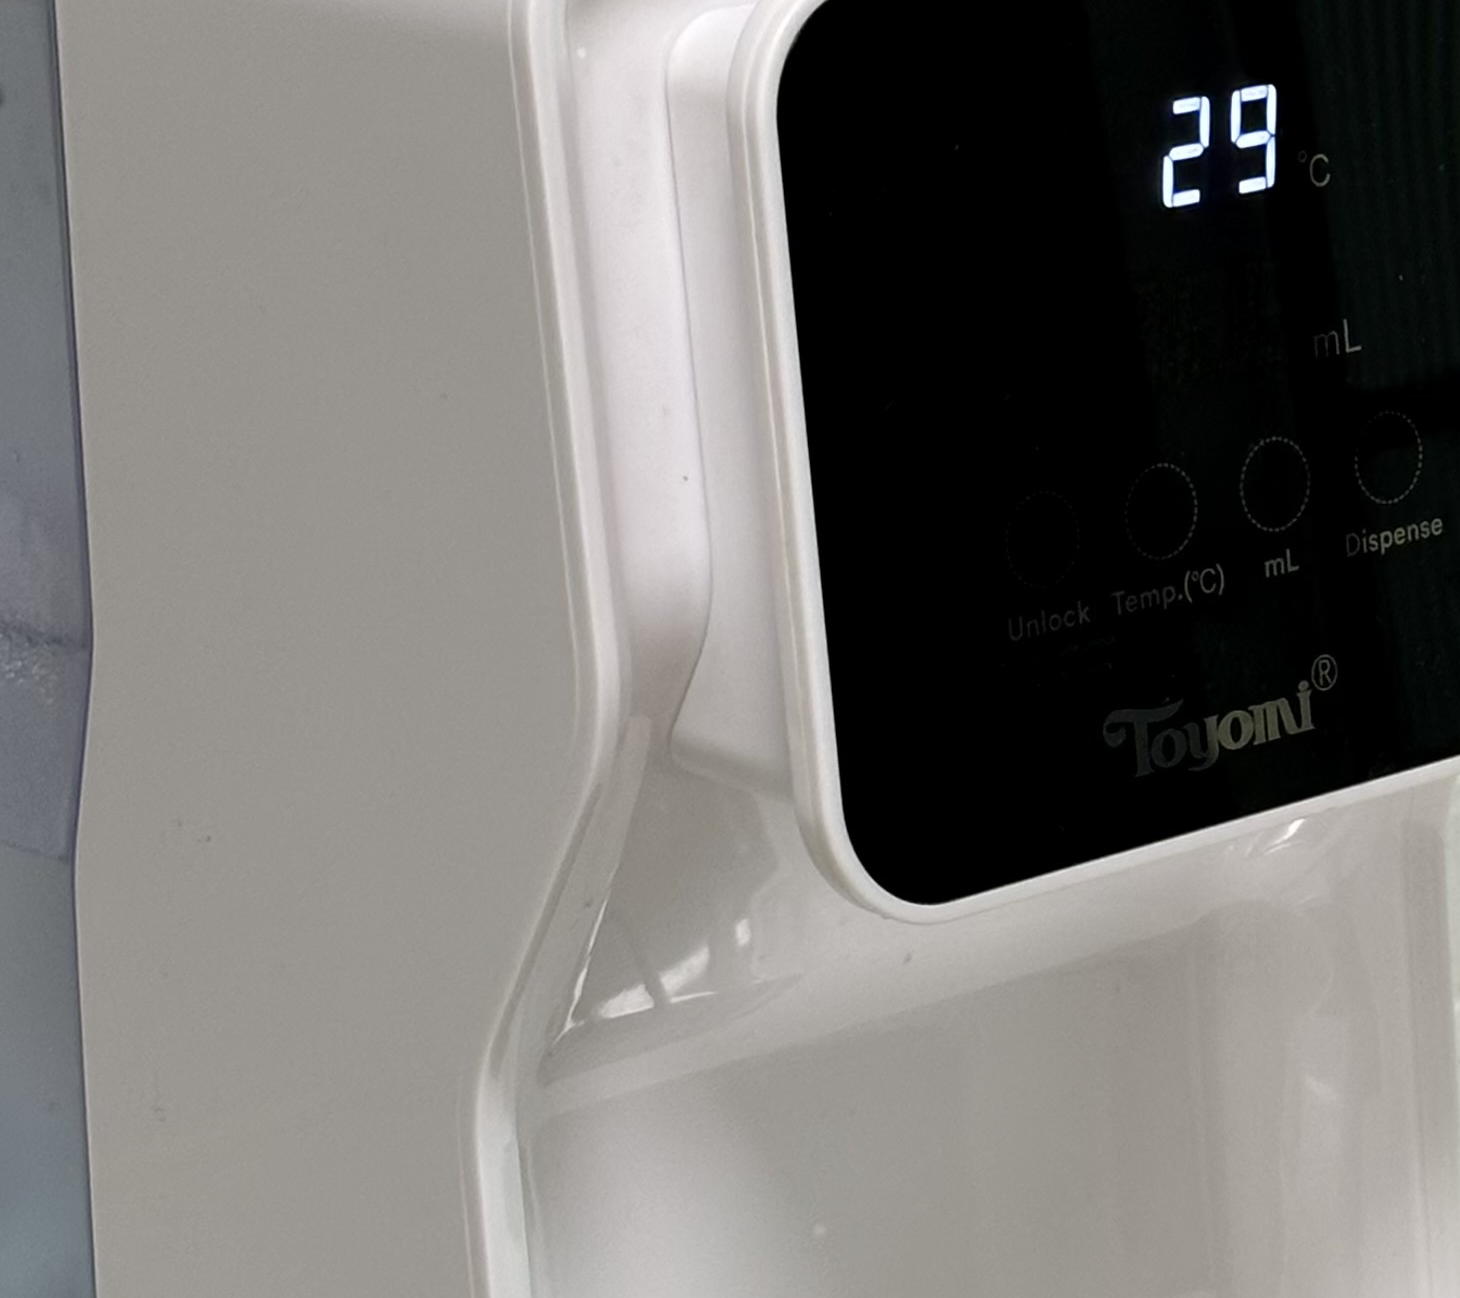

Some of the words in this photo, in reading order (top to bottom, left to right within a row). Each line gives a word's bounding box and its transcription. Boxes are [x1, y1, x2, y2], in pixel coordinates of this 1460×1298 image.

[1161, 83, 1278, 209] 29
[1313, 319, 1363, 359] mL
[1344, 514, 1444, 558] Dispense
[1264, 548, 1299, 579] mL
[1007, 600, 1092, 642] Unlock
